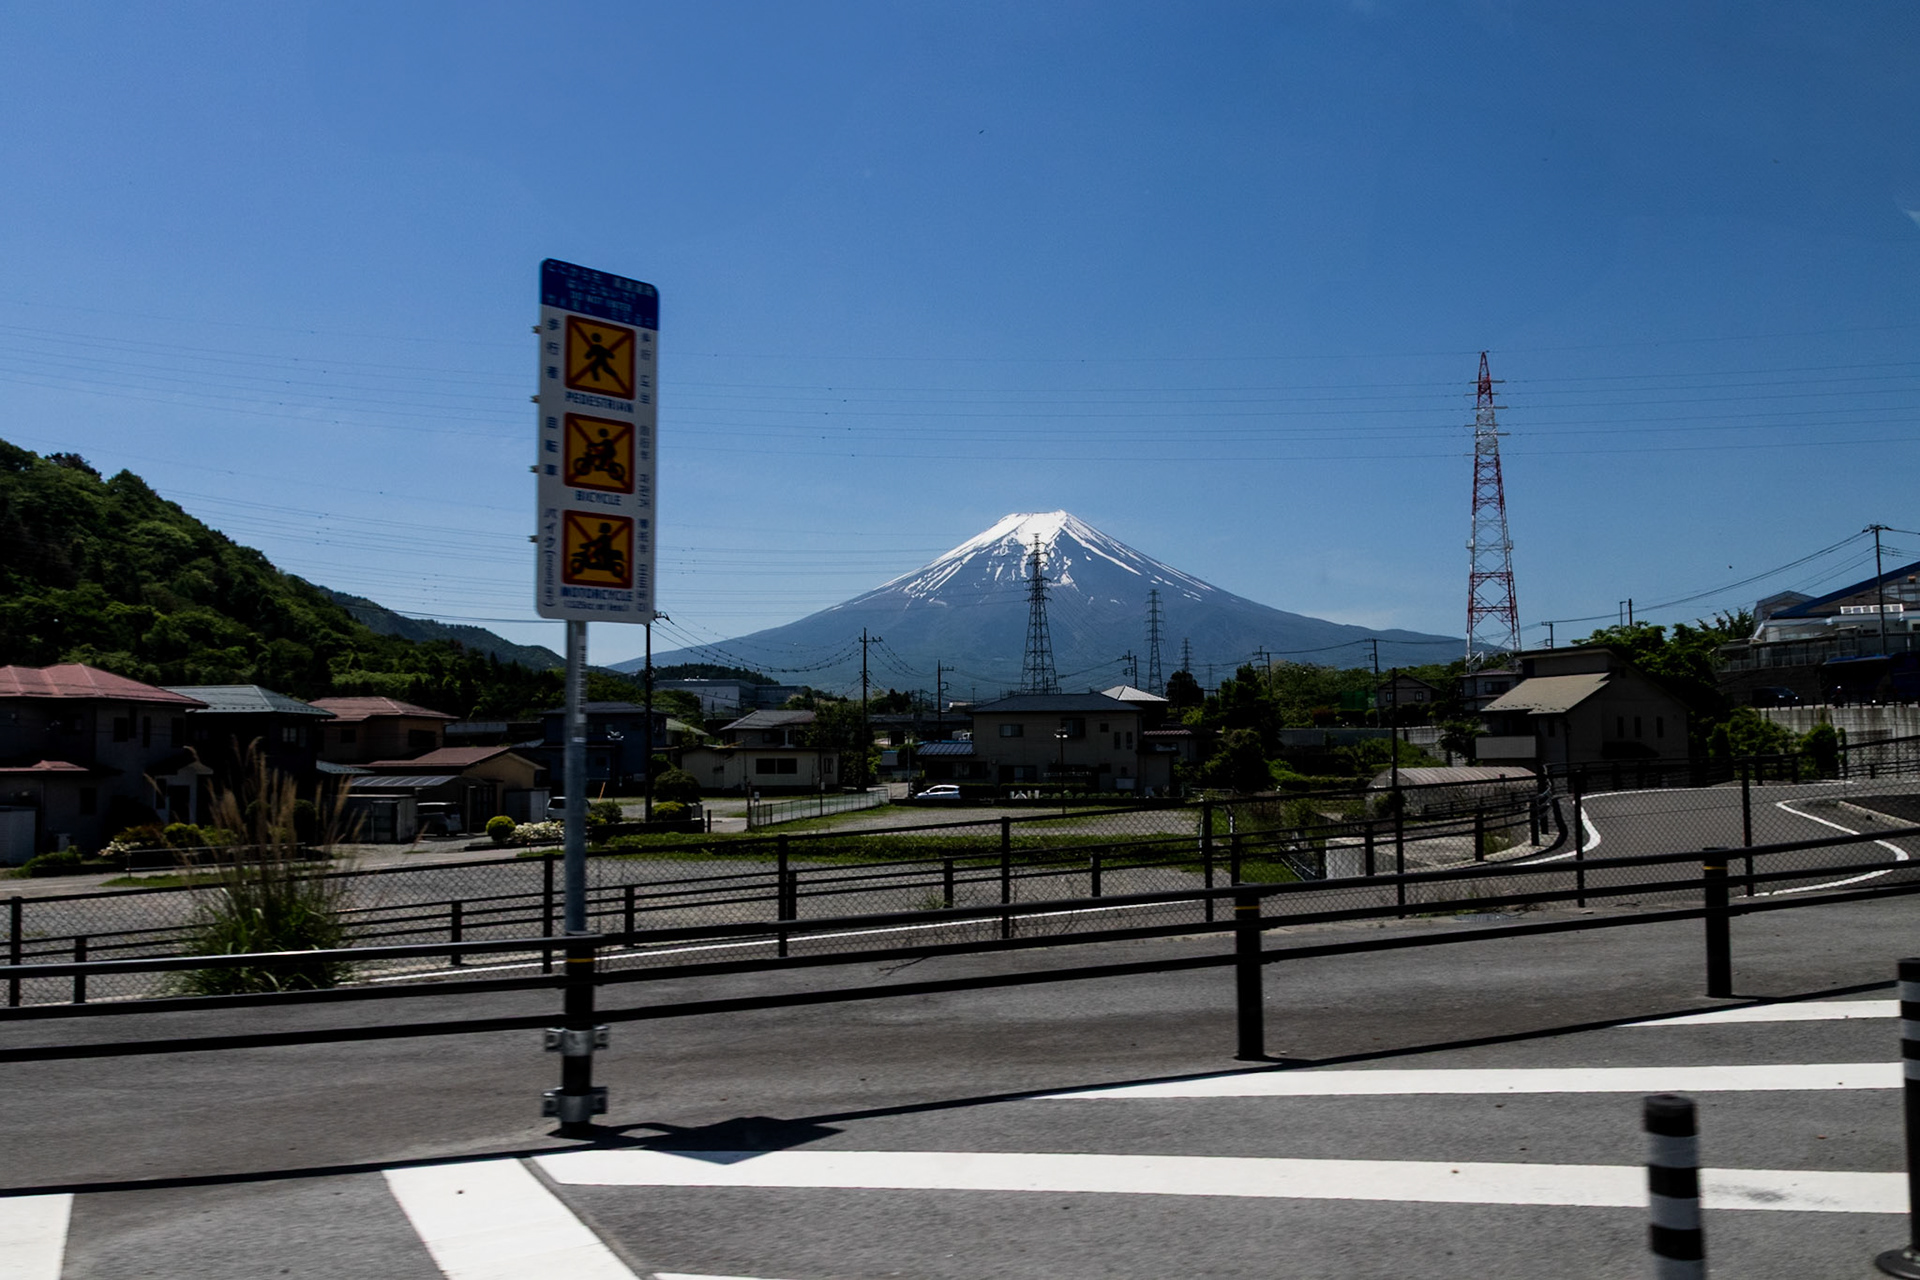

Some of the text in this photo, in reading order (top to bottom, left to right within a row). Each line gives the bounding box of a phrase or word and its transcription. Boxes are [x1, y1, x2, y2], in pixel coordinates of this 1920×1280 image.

[569, 291, 632, 312] DO NOT ENTER
[565, 391, 634, 413] PEDESTRIAN
[575, 490, 622, 506] BICYCLE
[560, 587, 634, 602] MOTORCYCLE
